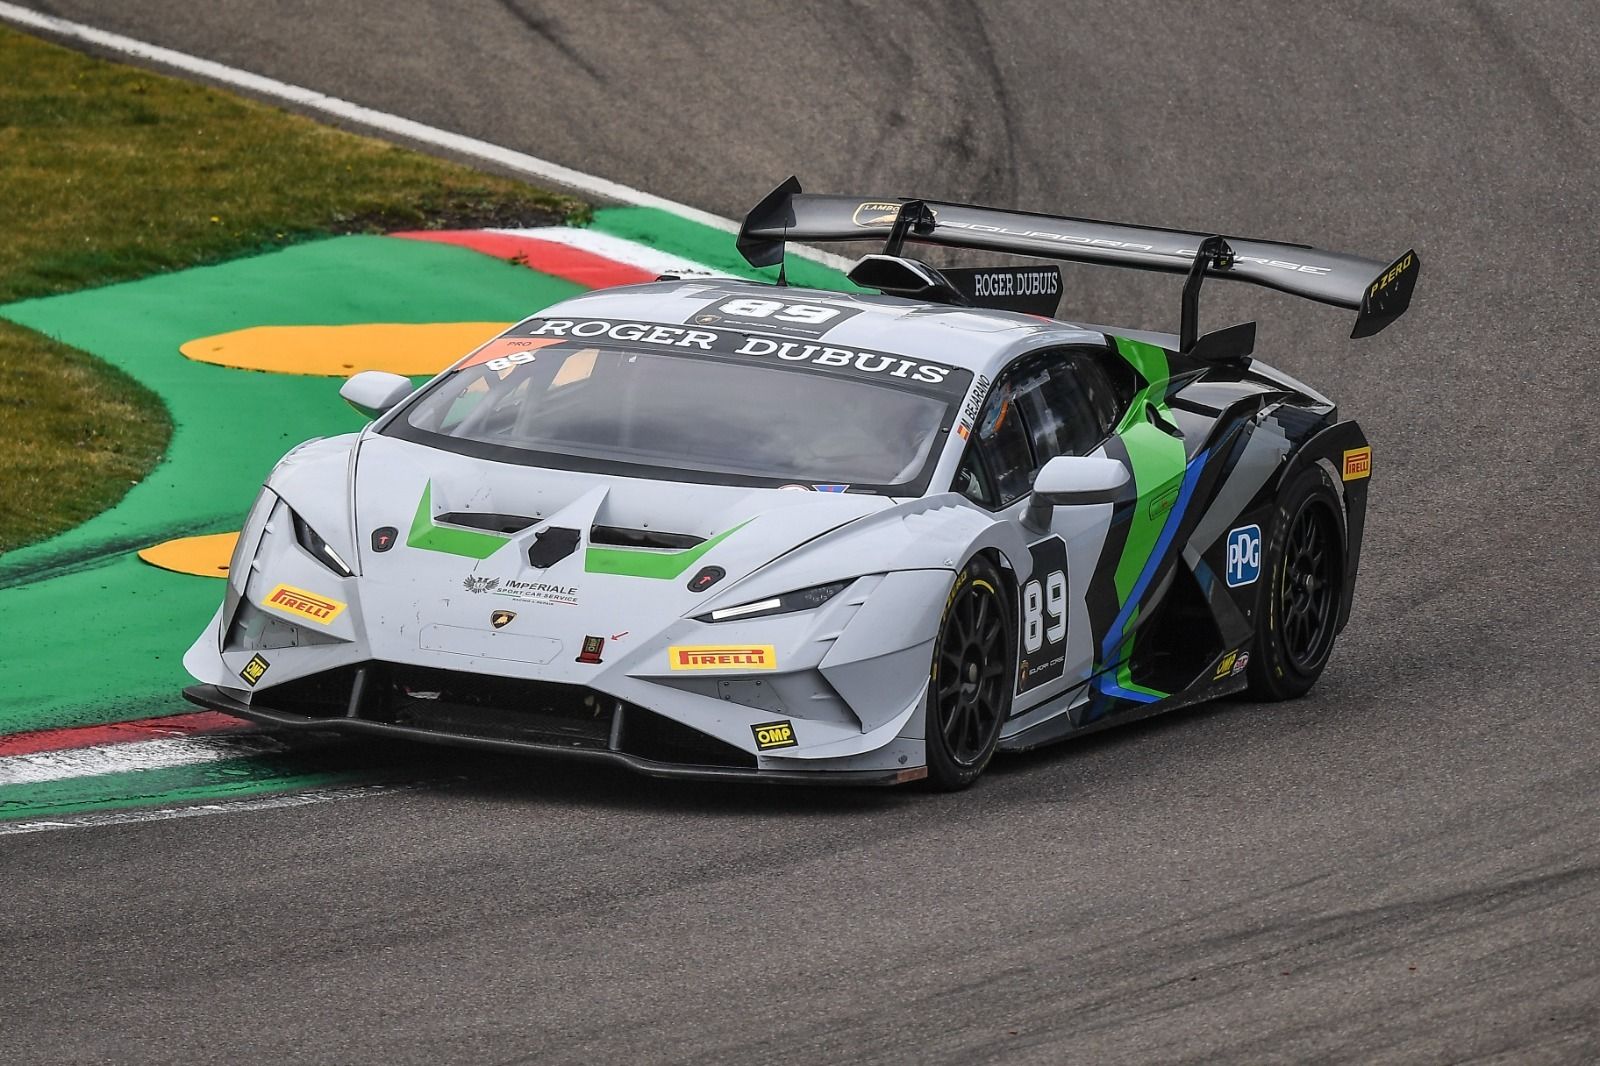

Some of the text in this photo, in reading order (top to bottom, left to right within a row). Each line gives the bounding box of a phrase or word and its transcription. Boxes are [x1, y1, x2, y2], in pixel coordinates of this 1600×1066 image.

[864, 204, 900, 214] LAMBO
[937, 220, 1332, 276] SQUADRA CRSE
[975, 271, 1058, 296] ROGER DUBUIS
[1371, 254, 1412, 298] P ZERO
[718, 299, 841, 324] 89
[485, 351, 537, 372] 89
[529, 320, 949, 384] ROGER DUBUIS
[960, 374, 990, 431] M. BEJARANO
[1345, 452, 1369, 475] PIRELLI
[1229, 533, 1259, 579] PPG
[497, 587, 523, 596] SPORT
[543, 593, 578, 603] SERVICE
[505, 579, 578, 596] IMPERIALE
[270, 588, 337, 619] PIRELLI
[1024, 570, 1067, 655] 89
[679, 649, 765, 665] PIRELLI
[1216, 653, 1236, 675] OMP
[246, 661, 264, 679] OMP
[757, 728, 791, 744] OMP
